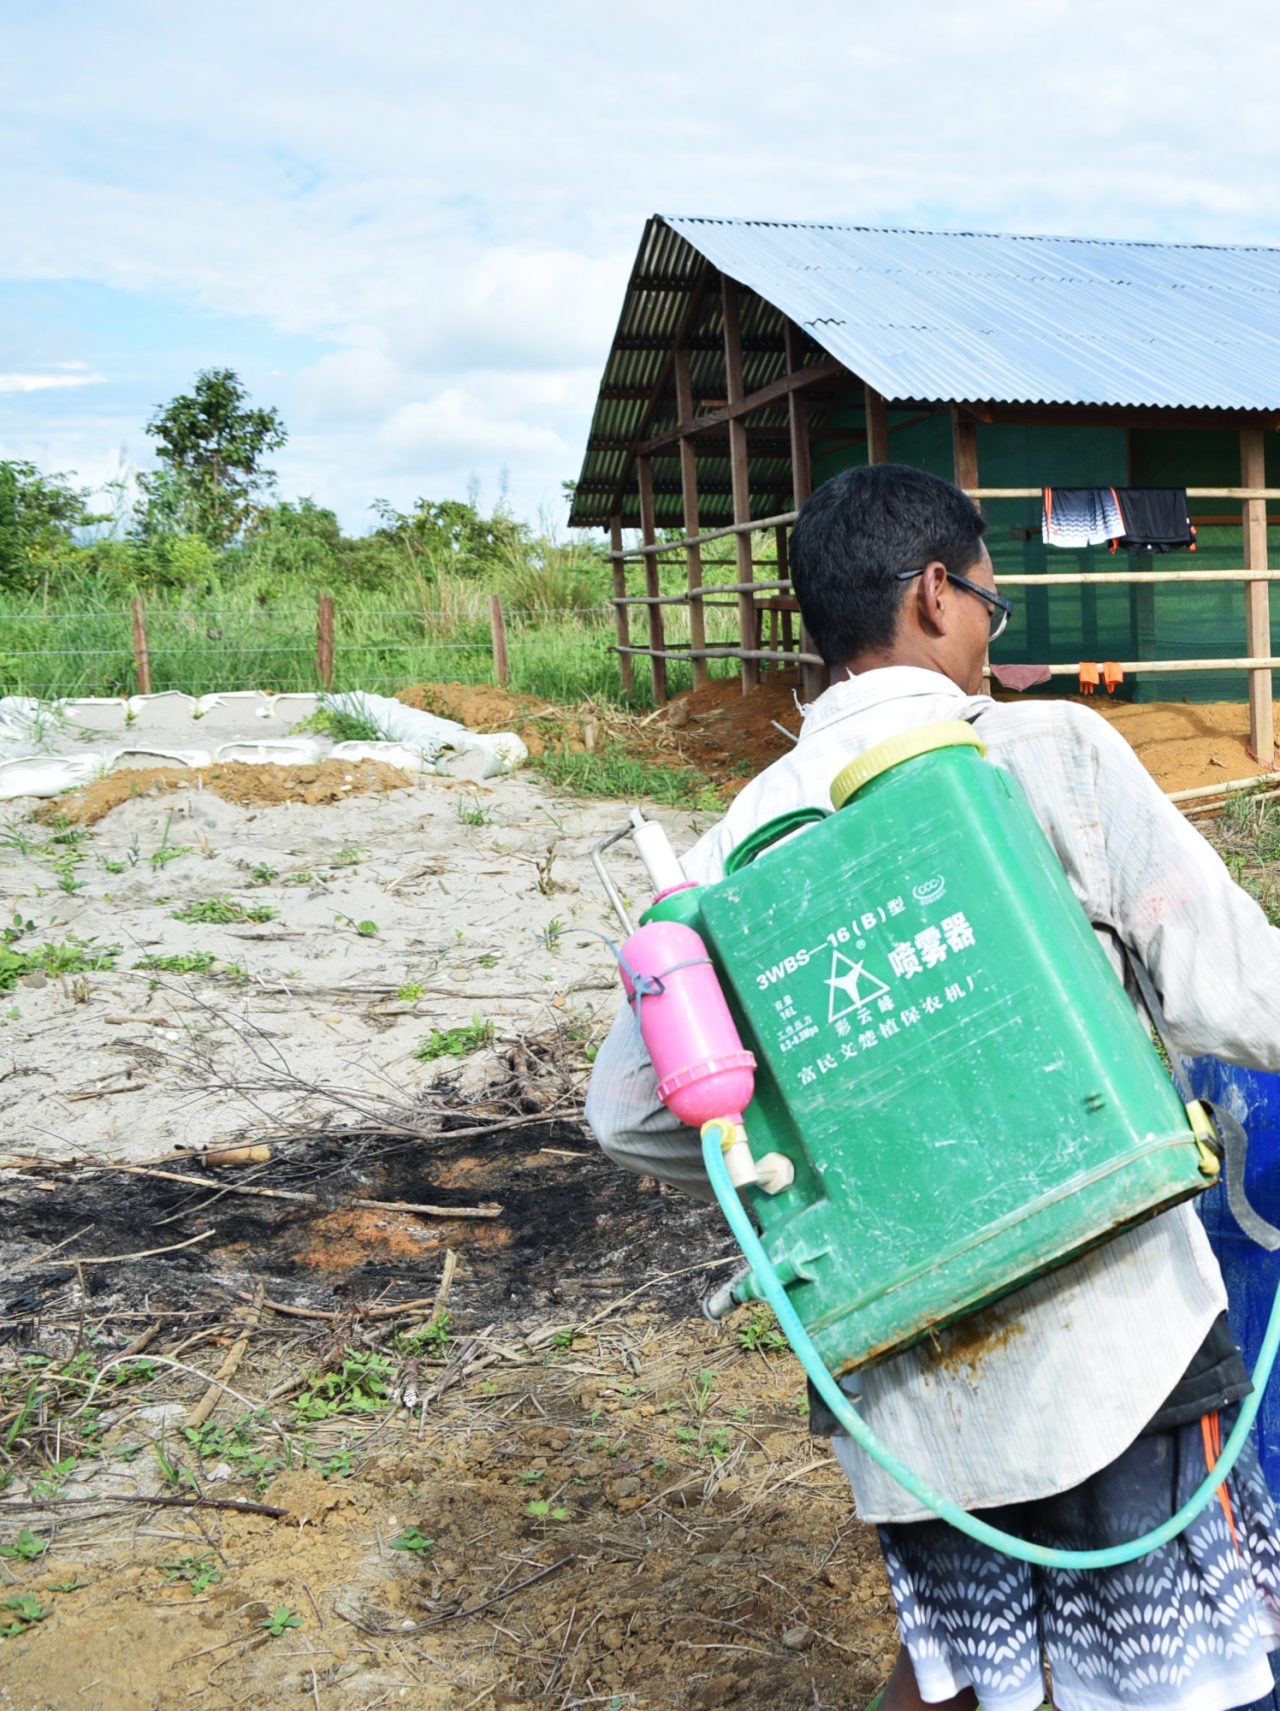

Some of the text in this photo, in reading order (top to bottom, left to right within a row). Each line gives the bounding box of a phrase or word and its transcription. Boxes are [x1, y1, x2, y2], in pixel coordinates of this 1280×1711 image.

[887, 911, 977, 980] 喷雾器
[797, 968, 984, 1086] 富民文楚植保农机厂
[834, 995, 896, 1038] 彩云峰
